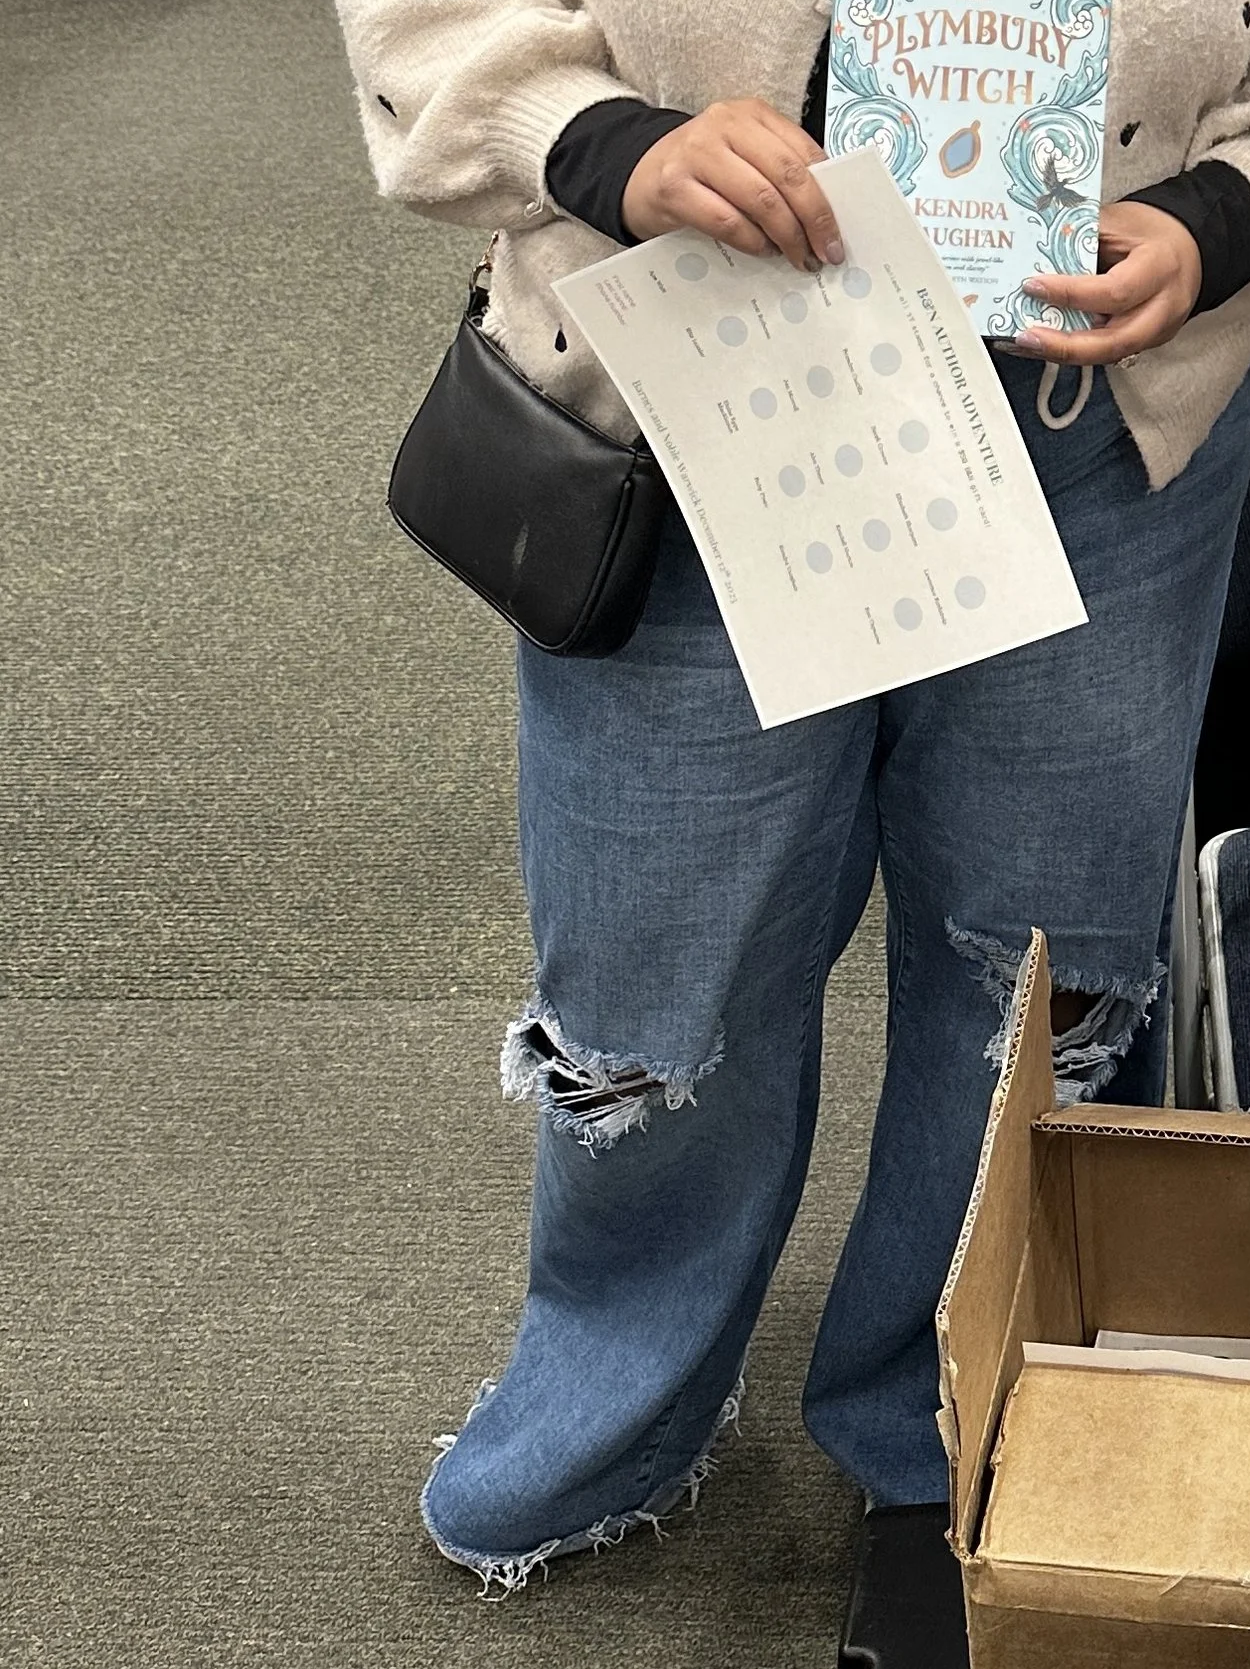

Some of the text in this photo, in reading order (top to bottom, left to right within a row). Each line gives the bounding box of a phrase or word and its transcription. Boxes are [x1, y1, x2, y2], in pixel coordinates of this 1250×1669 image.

[864, 9, 1074, 70] PLYMBURY
[893, 57, 1035, 105] WITCH
[914, 197, 1009, 221] KENDRA
[898, 295, 909, 309] all
[910, 325, 926, 352] stamps
[922, 354, 933, 369] for
[943, 410, 953, 421] to
[916, 286, 1004, 487] B&N AUTHOR ADVENTURE
[631, 379, 655, 413] Barnes
[650, 413, 667, 433] and
[660, 432, 682, 462] Noble
[676, 462, 702, 506] Warwick
[695, 507, 723, 561] December
